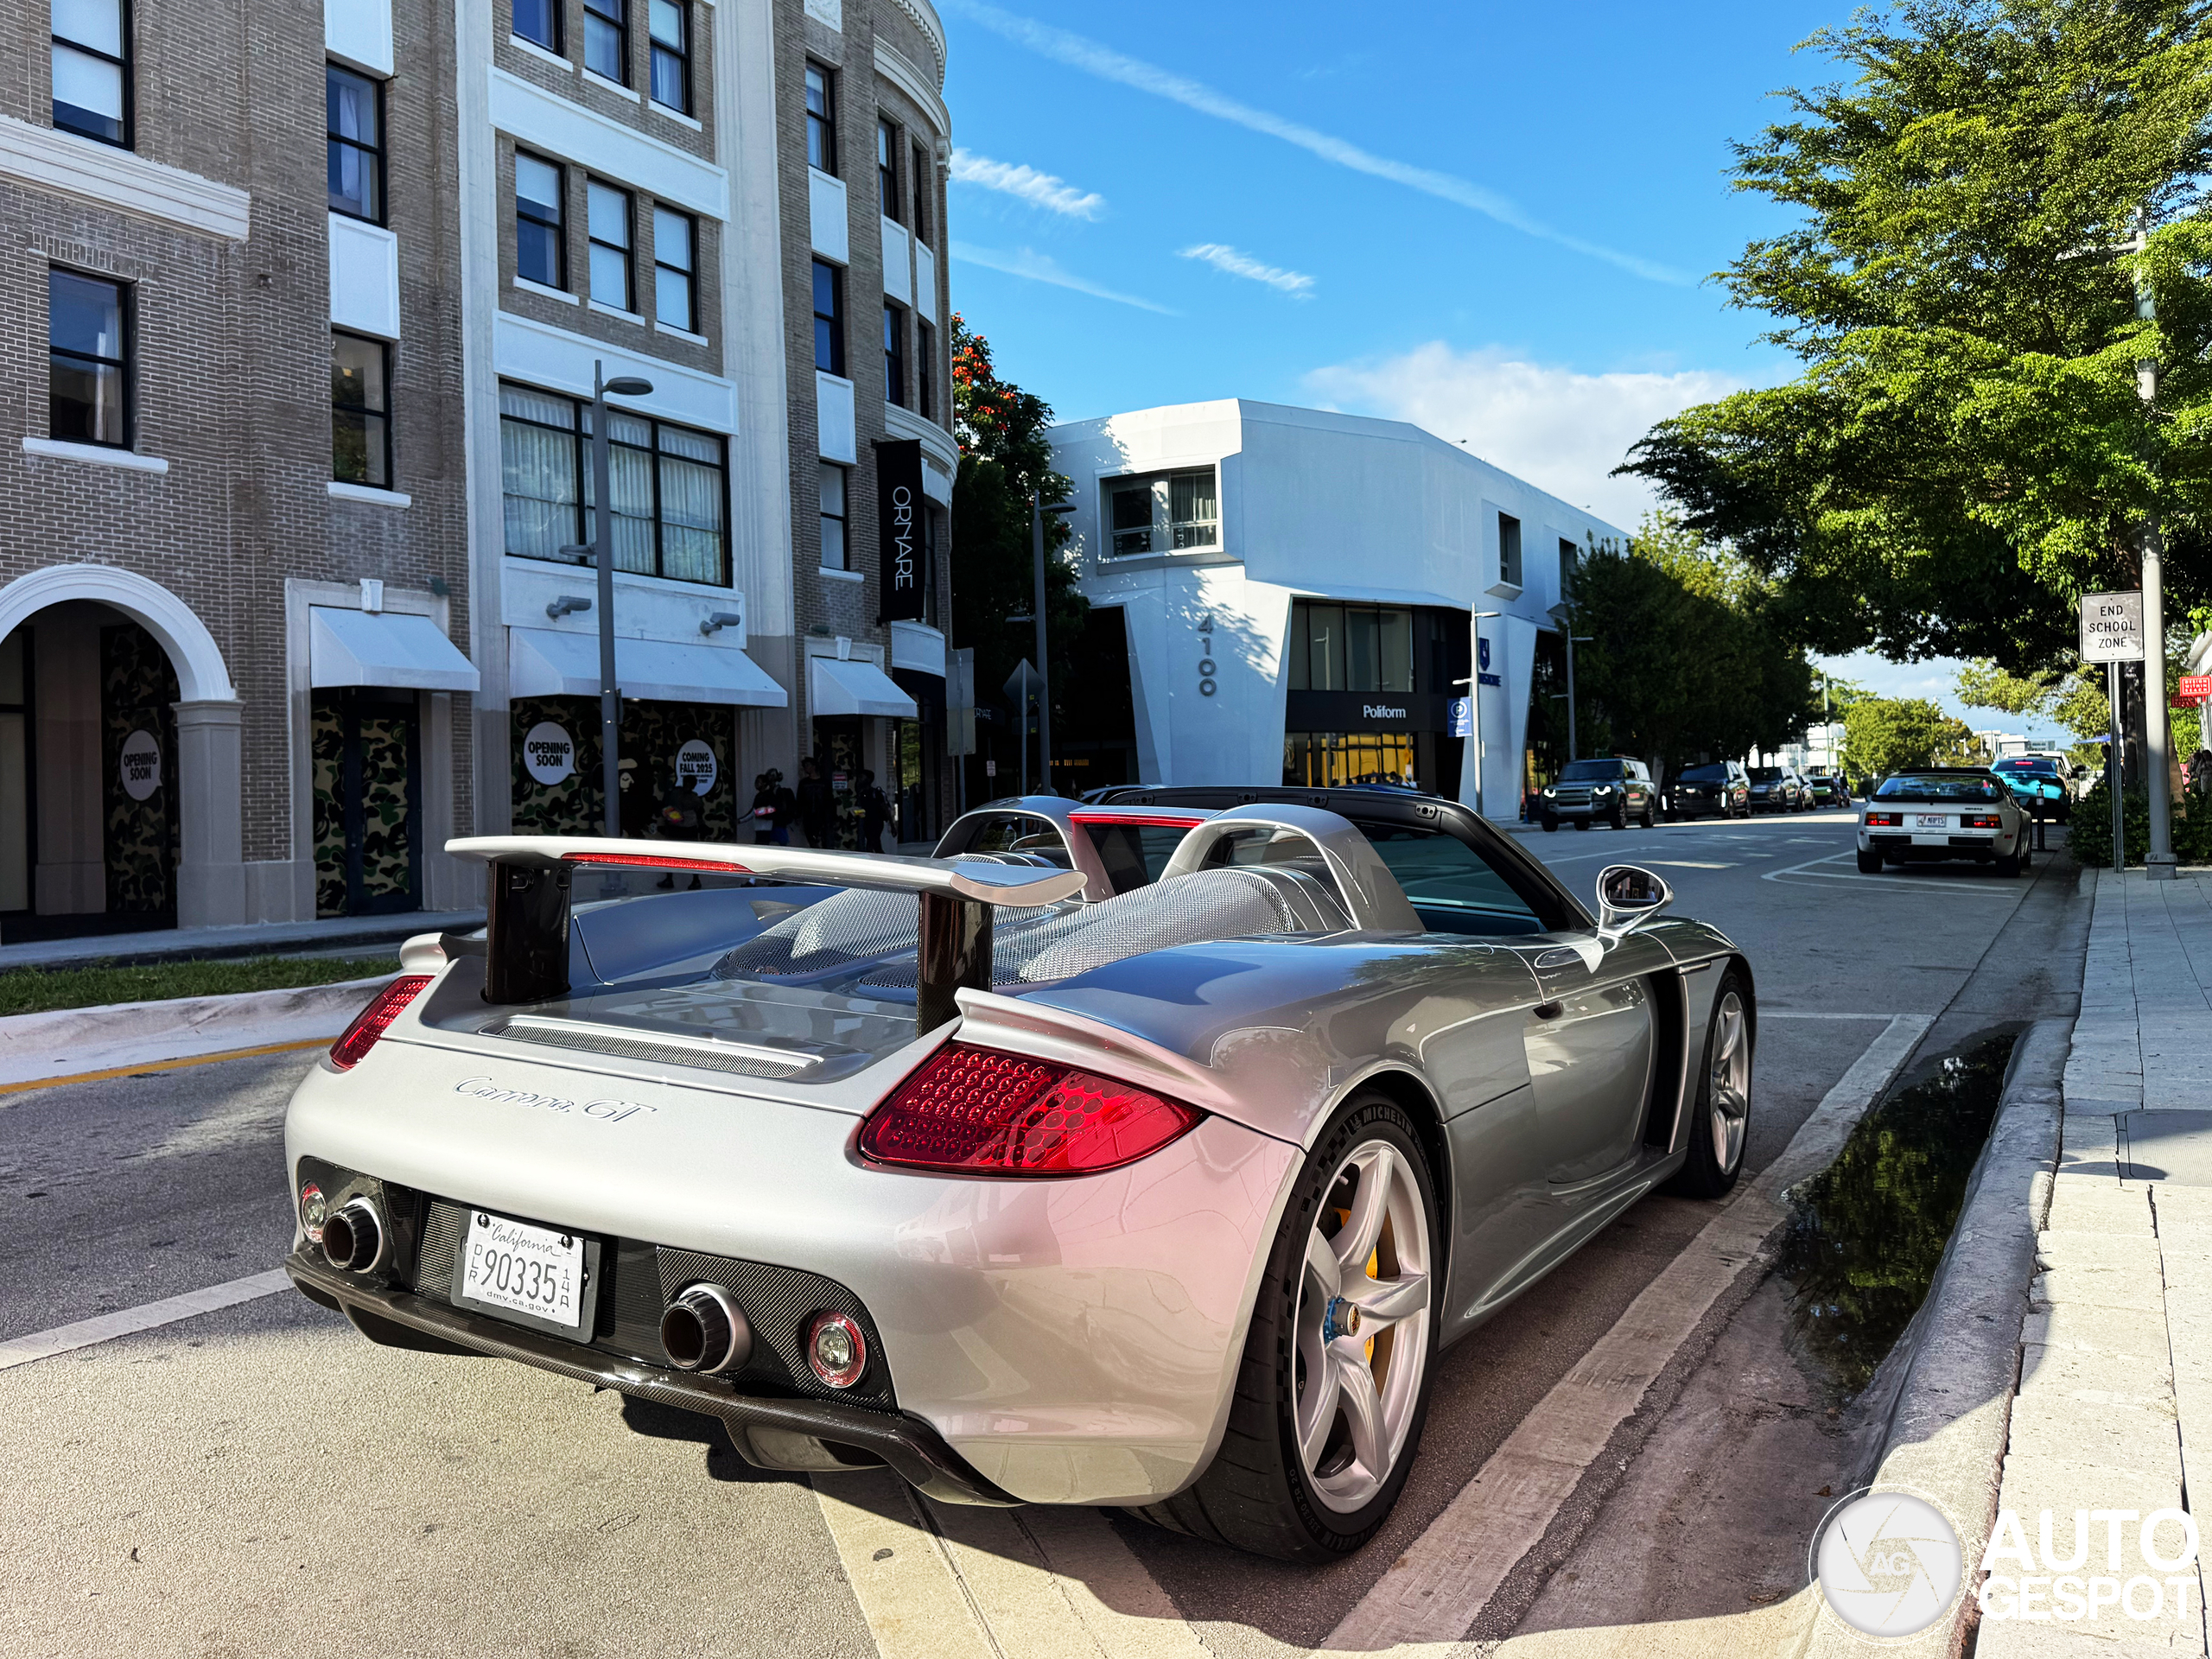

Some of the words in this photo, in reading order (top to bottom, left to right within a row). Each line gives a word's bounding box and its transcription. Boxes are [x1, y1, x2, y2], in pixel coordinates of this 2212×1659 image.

[893, 486, 912, 591] ORNARE
[2101, 605, 2123, 616] END
[2089, 620, 2136, 632] SCHOOL
[2099, 637, 2126, 648] ZONE
[1198, 613, 1217, 696] 4100
[1363, 704, 1406, 718] Poliform
[528, 741, 570, 754] OPENING
[124, 752, 157, 767] OPENING
[537, 754, 563, 766] SOON
[683, 752, 709, 762] COMING
[130, 766, 151, 780] SOON
[680, 763, 695, 773] FALL
[696, 763, 713, 773] 2025
[453, 1076, 574, 1113] Carrera
[582, 1098, 658, 1122] GT
[1363, 1106, 1413, 1136] MICHELIN
[492, 1224, 561, 1256] California
[468, 1243, 483, 1283] DLR
[480, 1249, 557, 1304] 90335
[486, 1290, 549, 1313] dmv.ca.gov
[1289, 1469, 1298, 1484] 20
